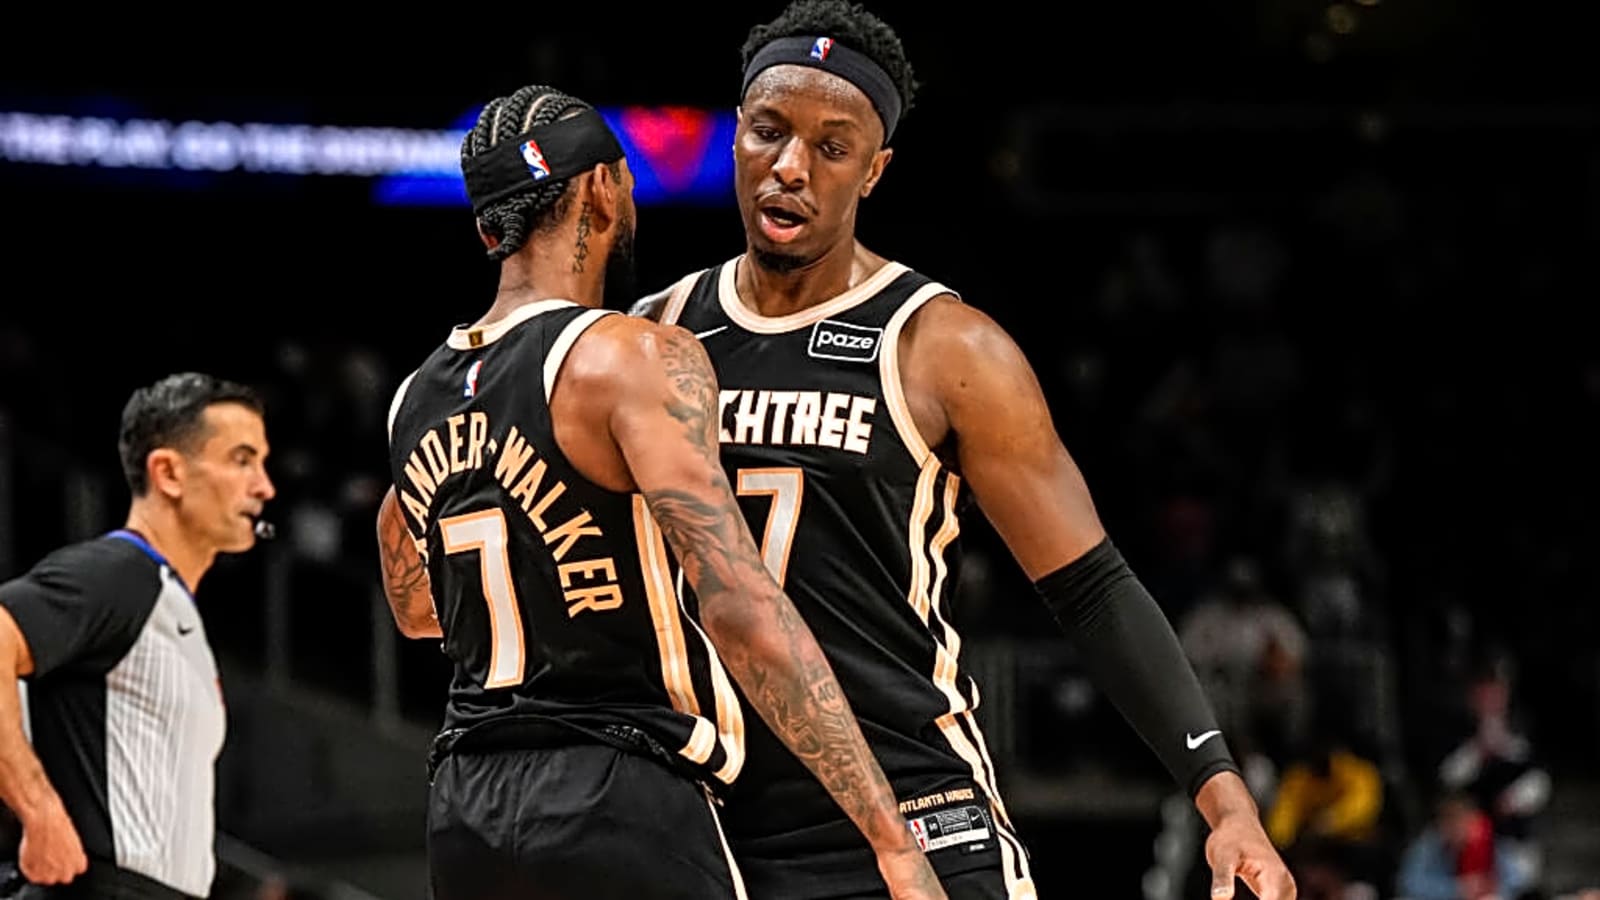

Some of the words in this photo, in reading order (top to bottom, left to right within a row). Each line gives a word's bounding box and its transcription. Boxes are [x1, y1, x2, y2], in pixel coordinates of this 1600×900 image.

[817, 331, 874, 349] paze
[736, 467, 804, 589] 7
[438, 507, 526, 689] 7
[899, 794, 945, 813] ATLANTA
